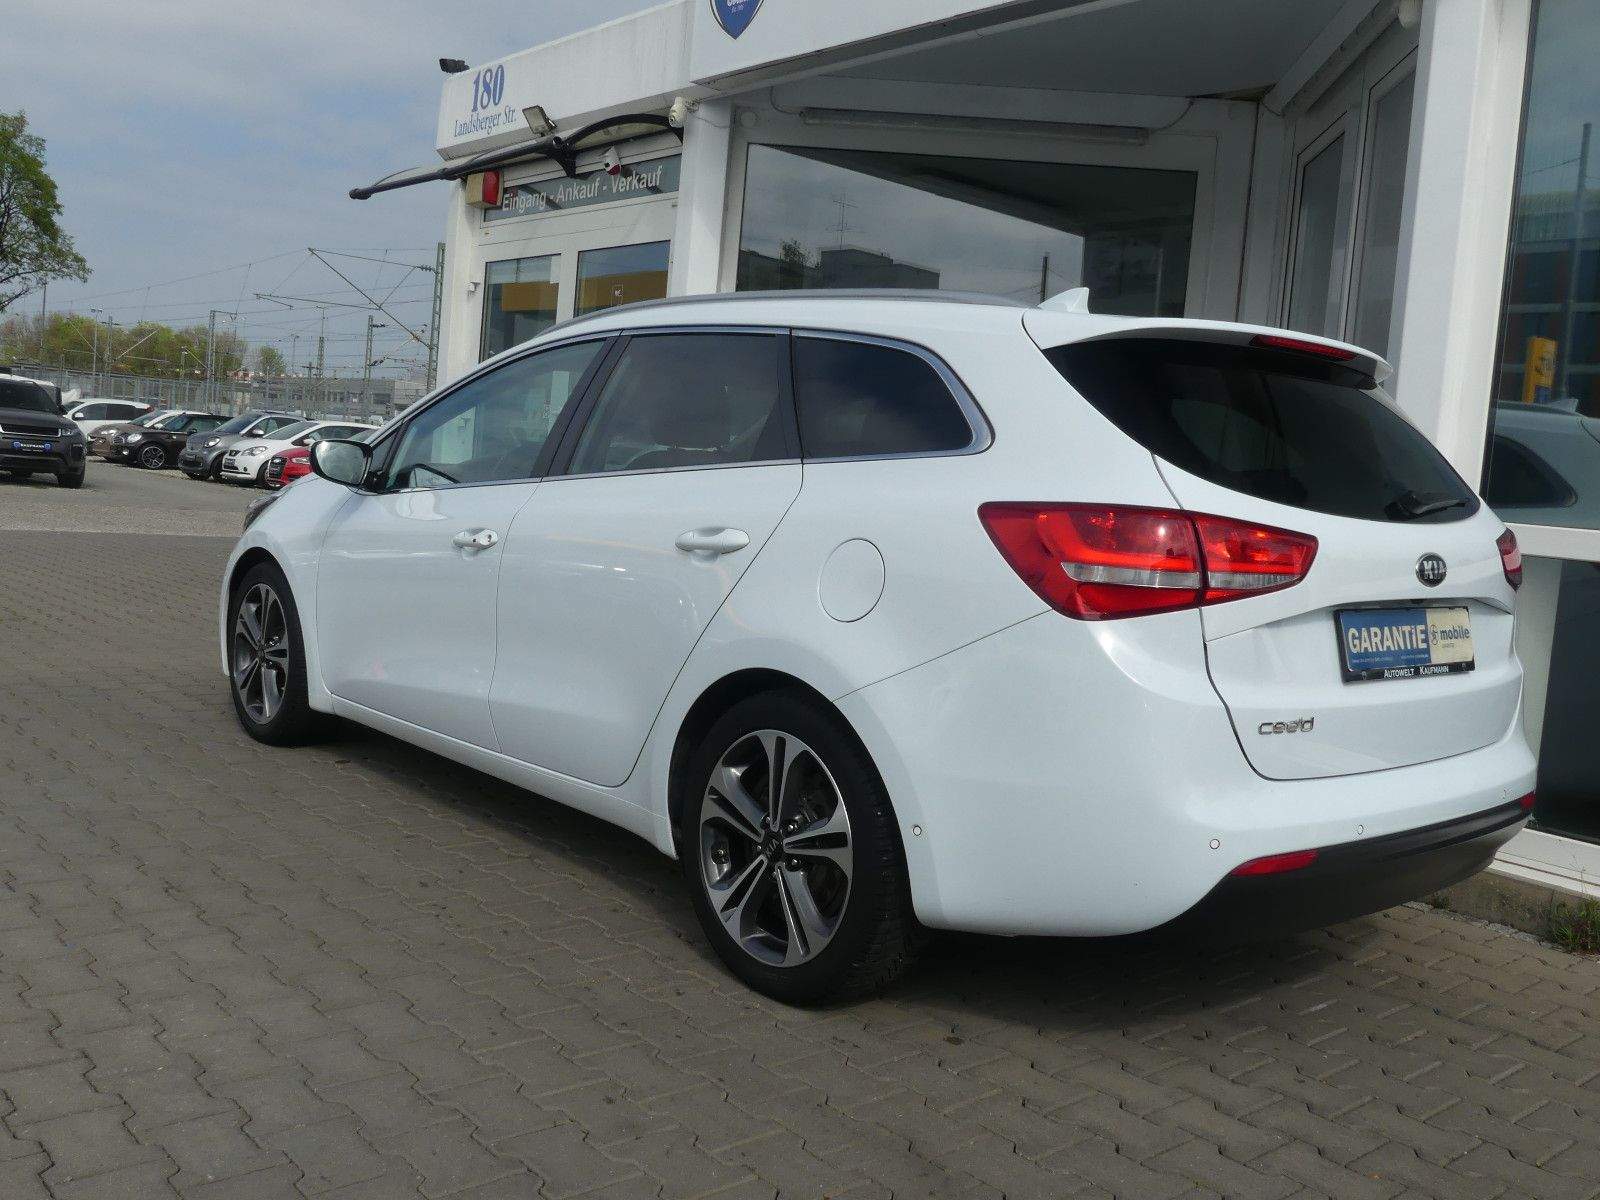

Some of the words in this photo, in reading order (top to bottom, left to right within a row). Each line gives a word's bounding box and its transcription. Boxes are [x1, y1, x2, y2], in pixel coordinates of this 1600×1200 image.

[472, 64, 505, 112] 180
[454, 115, 501, 137] Landsberger
[504, 106, 517, 123] Str.
[502, 191, 547, 212] Eingang
[556, 178, 601, 203] Ankauf
[611, 165, 663, 194] Verkauf
[1440, 625, 1470, 641] mobile
[1384, 668, 1415, 679] AUTOWELT
[1419, 665, 1449, 675] KAUFMANN
